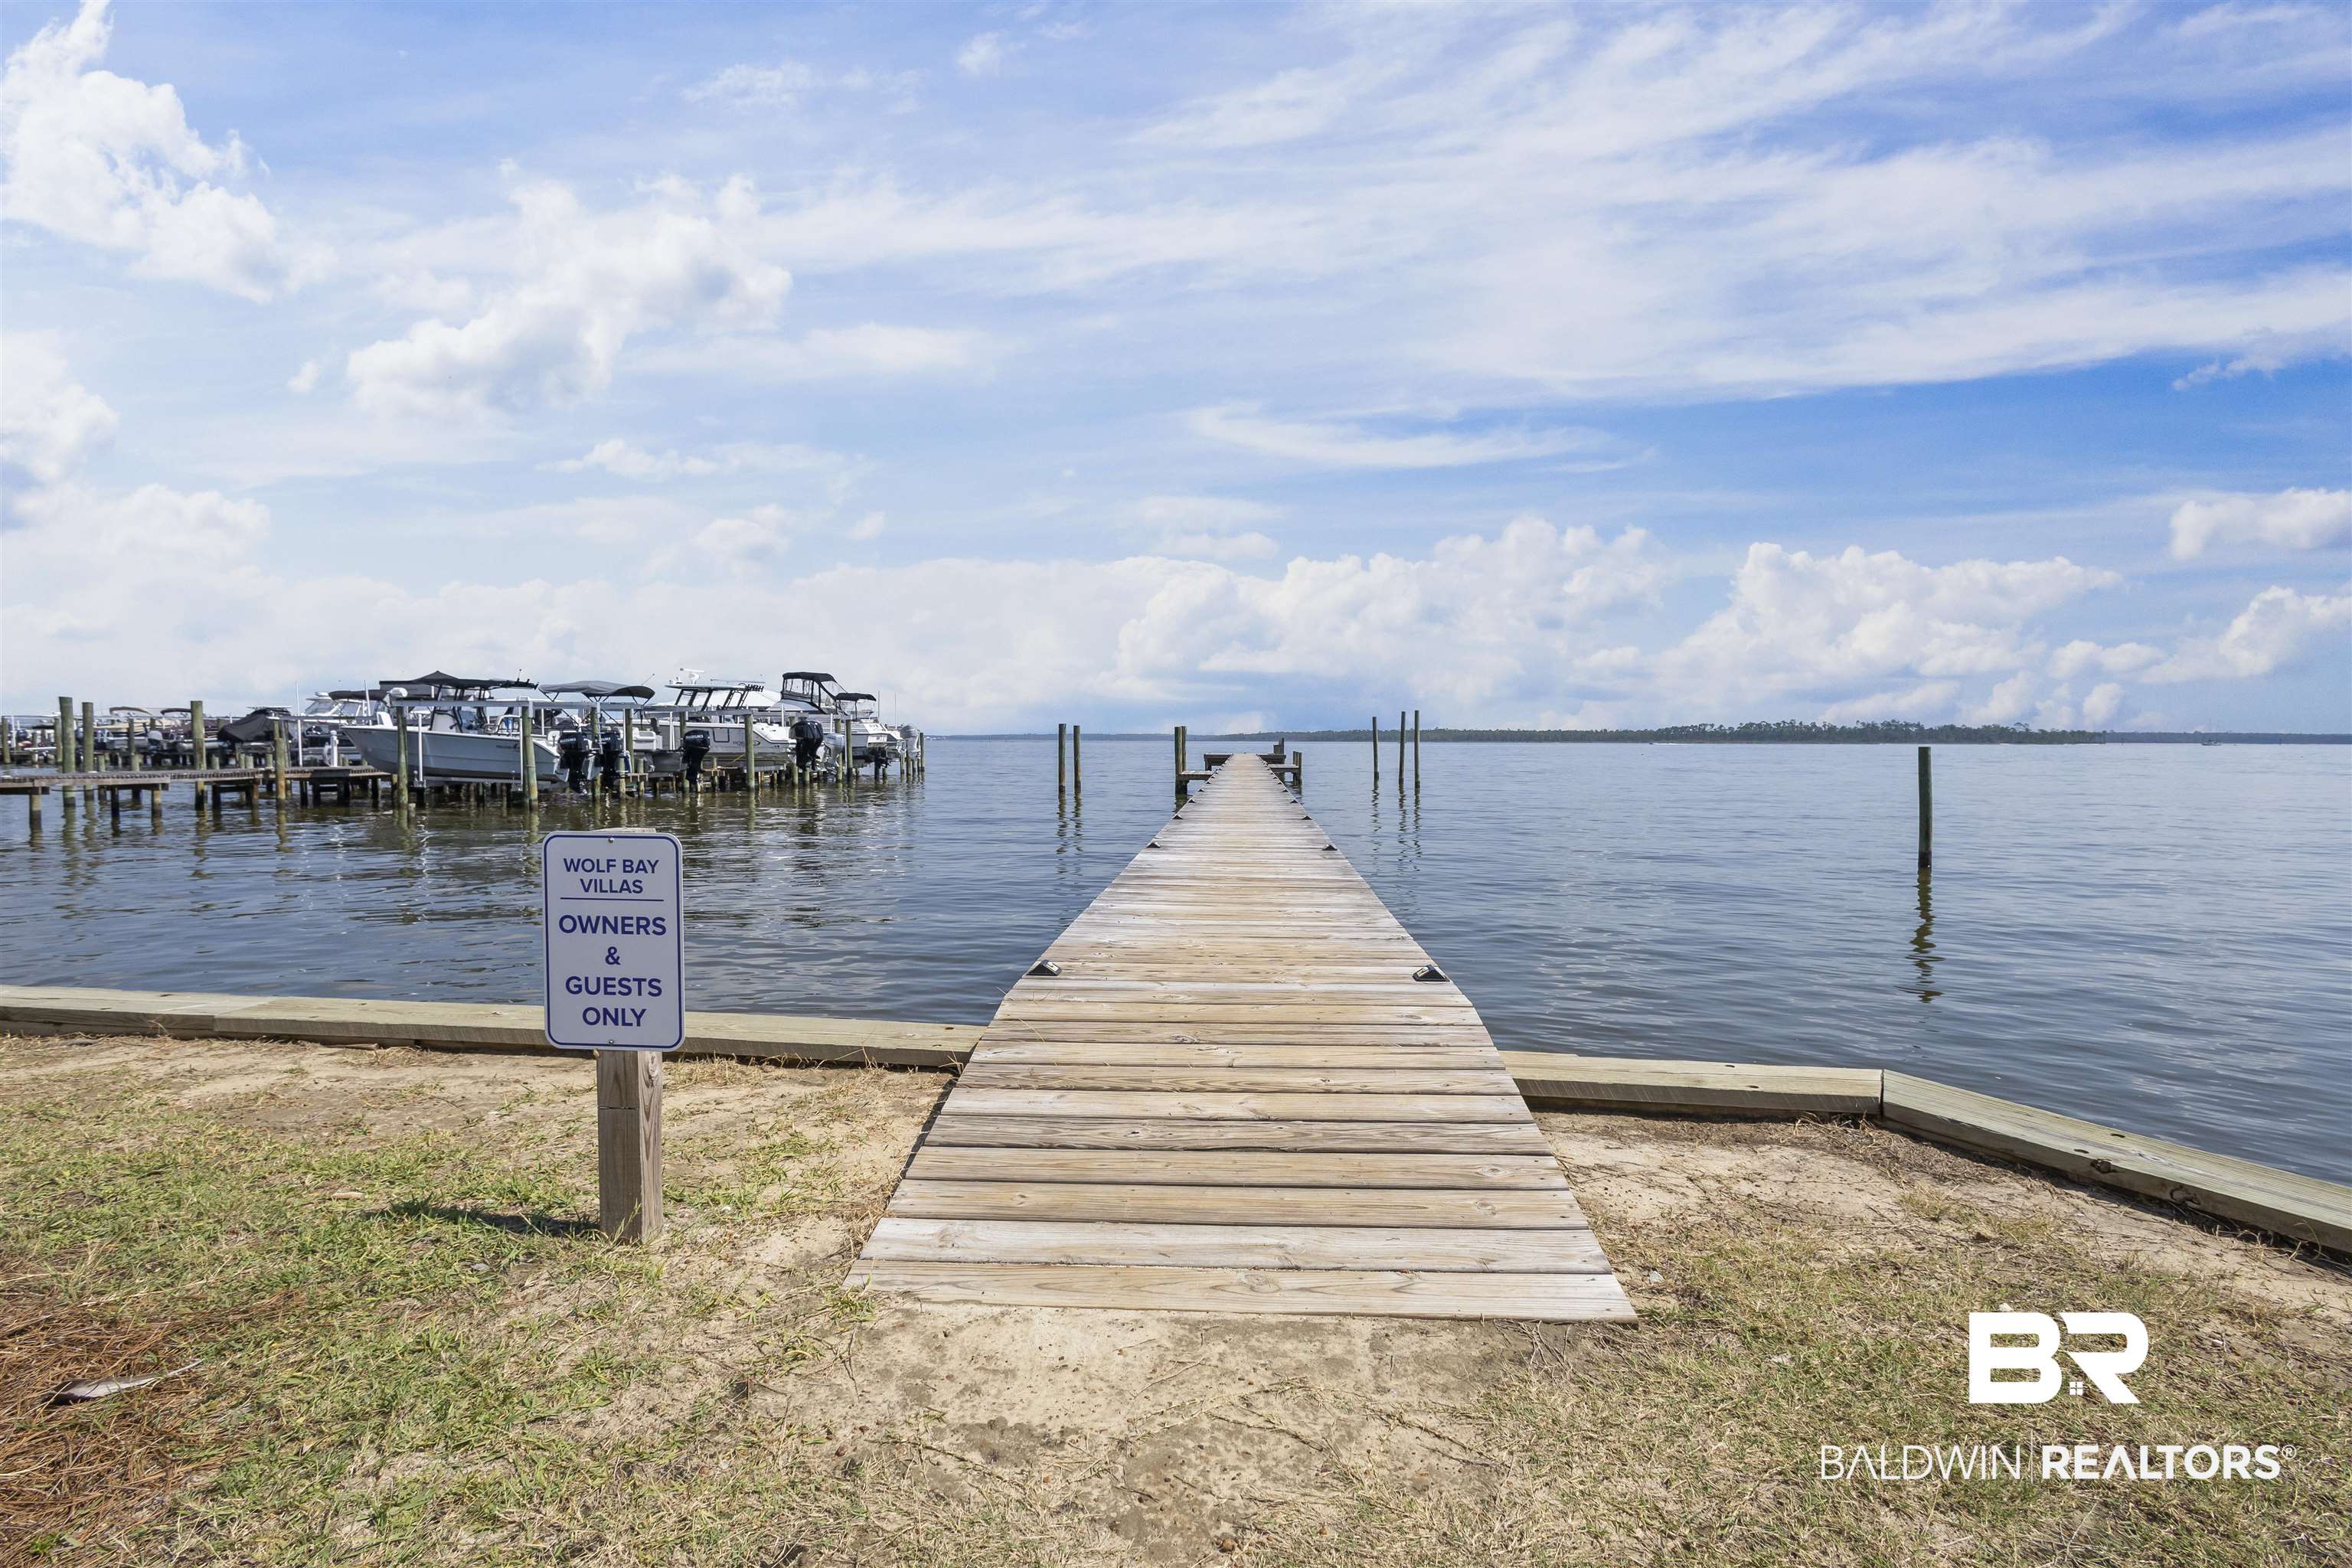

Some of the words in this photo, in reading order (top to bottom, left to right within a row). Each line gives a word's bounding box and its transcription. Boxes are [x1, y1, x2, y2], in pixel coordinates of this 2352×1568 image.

[564, 858, 616, 874] WOLF
[622, 859, 660, 874] BAY
[580, 878, 644, 894] VILLAS
[558, 914, 667, 936] OWNERS
[605, 946, 622, 965] &
[565, 975, 663, 998] GUESTS
[582, 1006, 647, 1027] ONLY
